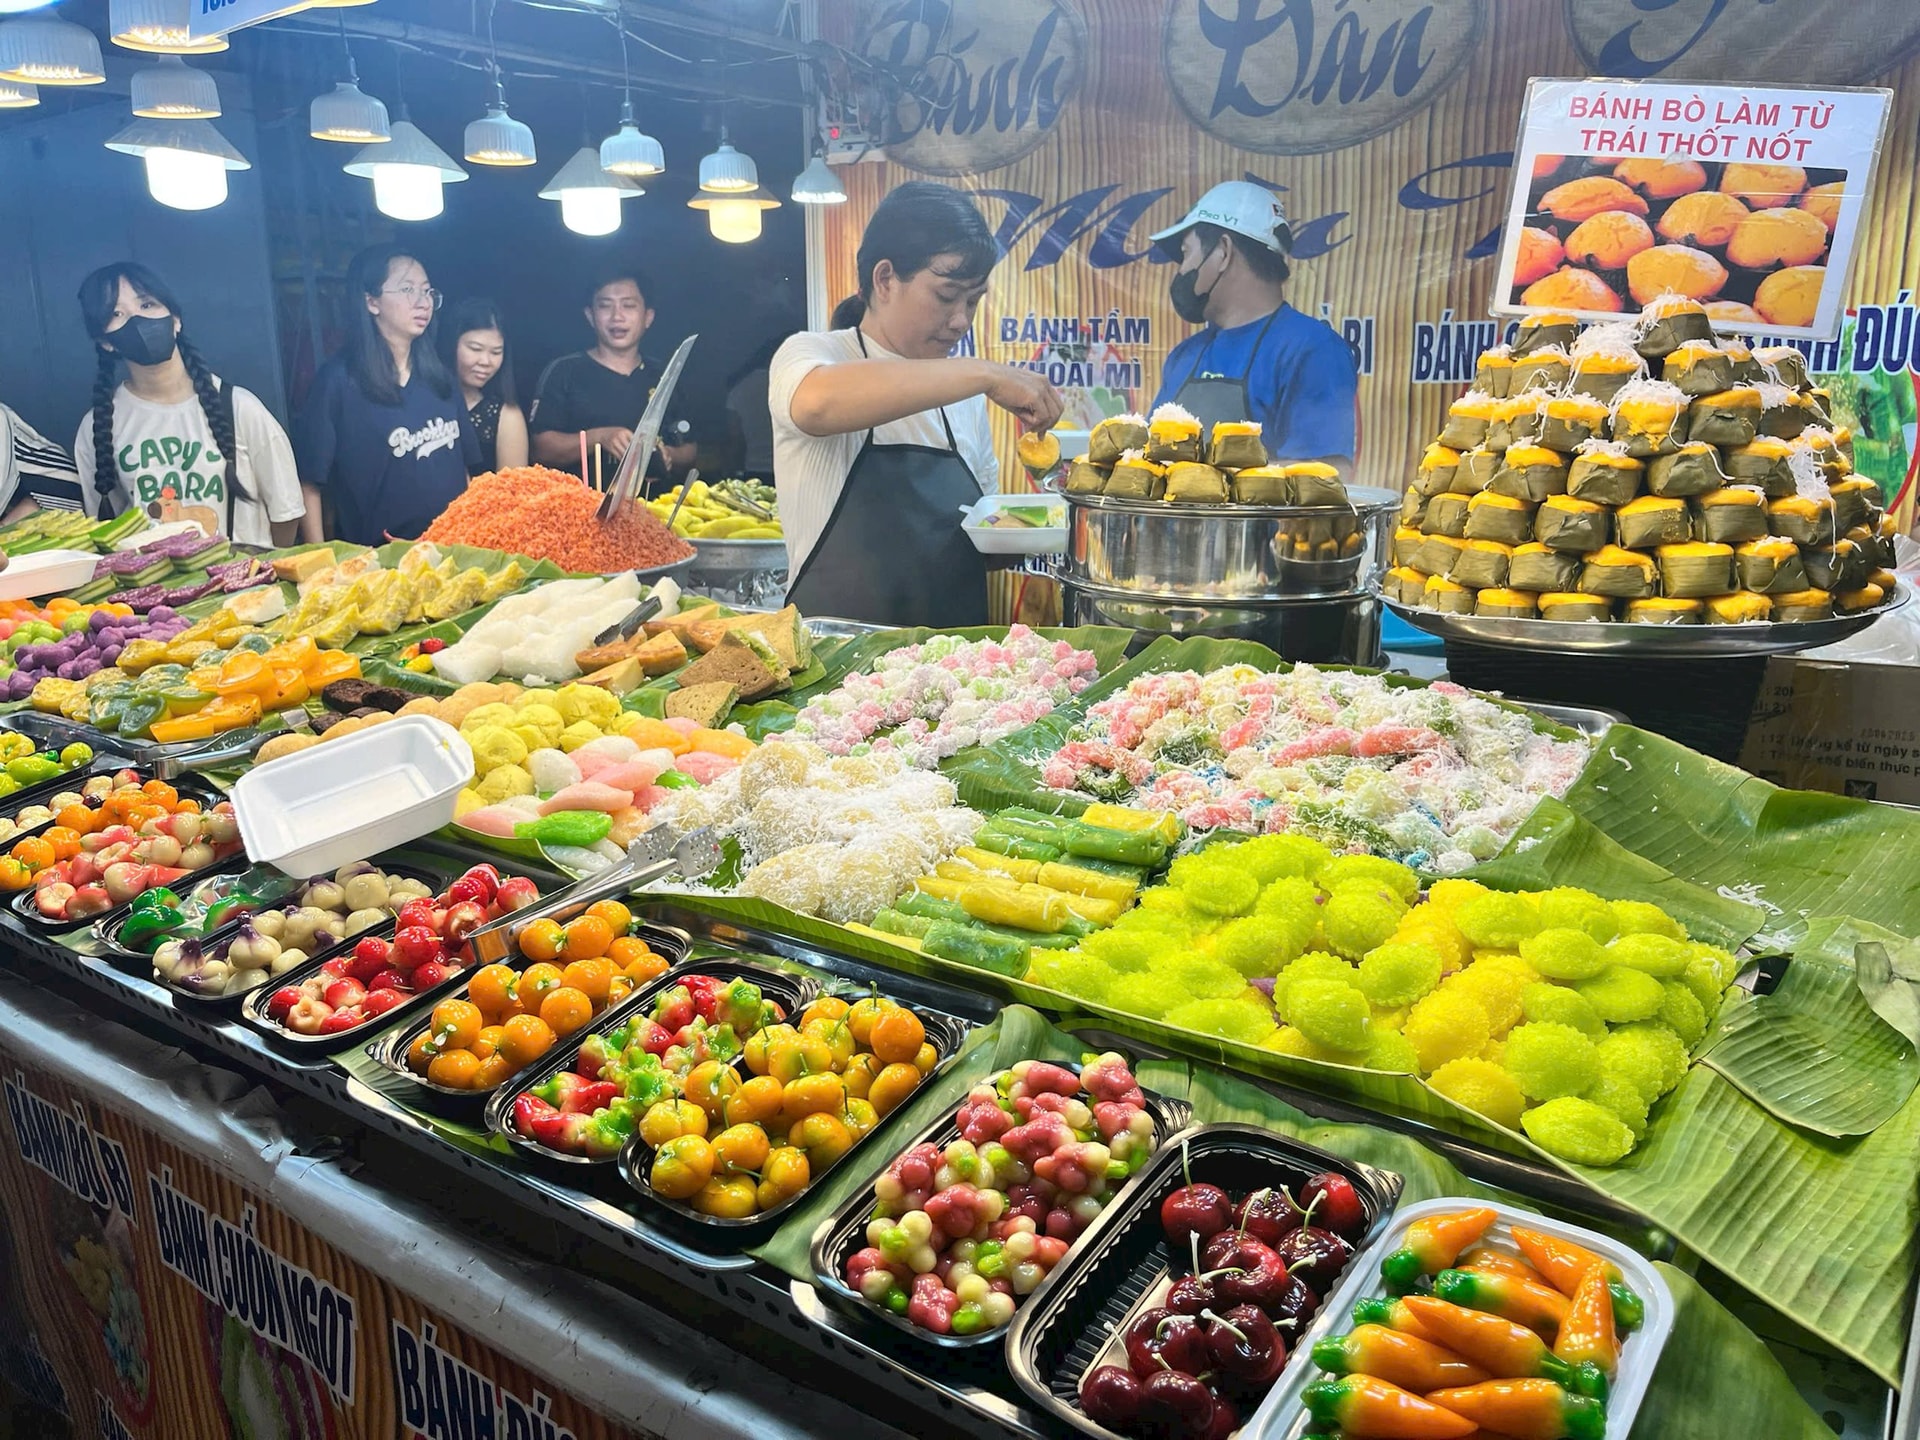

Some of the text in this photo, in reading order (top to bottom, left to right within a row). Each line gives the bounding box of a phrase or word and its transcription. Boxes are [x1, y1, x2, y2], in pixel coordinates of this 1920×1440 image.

[1569, 91, 1835, 129] BÁNH BÒ LÀM TỪ
[1580, 125, 1813, 162] TRÁI THỐT NỐT
[1000, 313, 1079, 343] BÁNH
[1087, 308, 1151, 344] TẦM
[1104, 357, 1142, 388] MÌ
[136, 471, 224, 503] BARA
[1873, 743, 1909, 760] ngày
[6, 1072, 138, 1224] BÁNH BÒ BI
[150, 1167, 217, 1298] BÁNH
[213, 1206, 289, 1345] CUỐN
